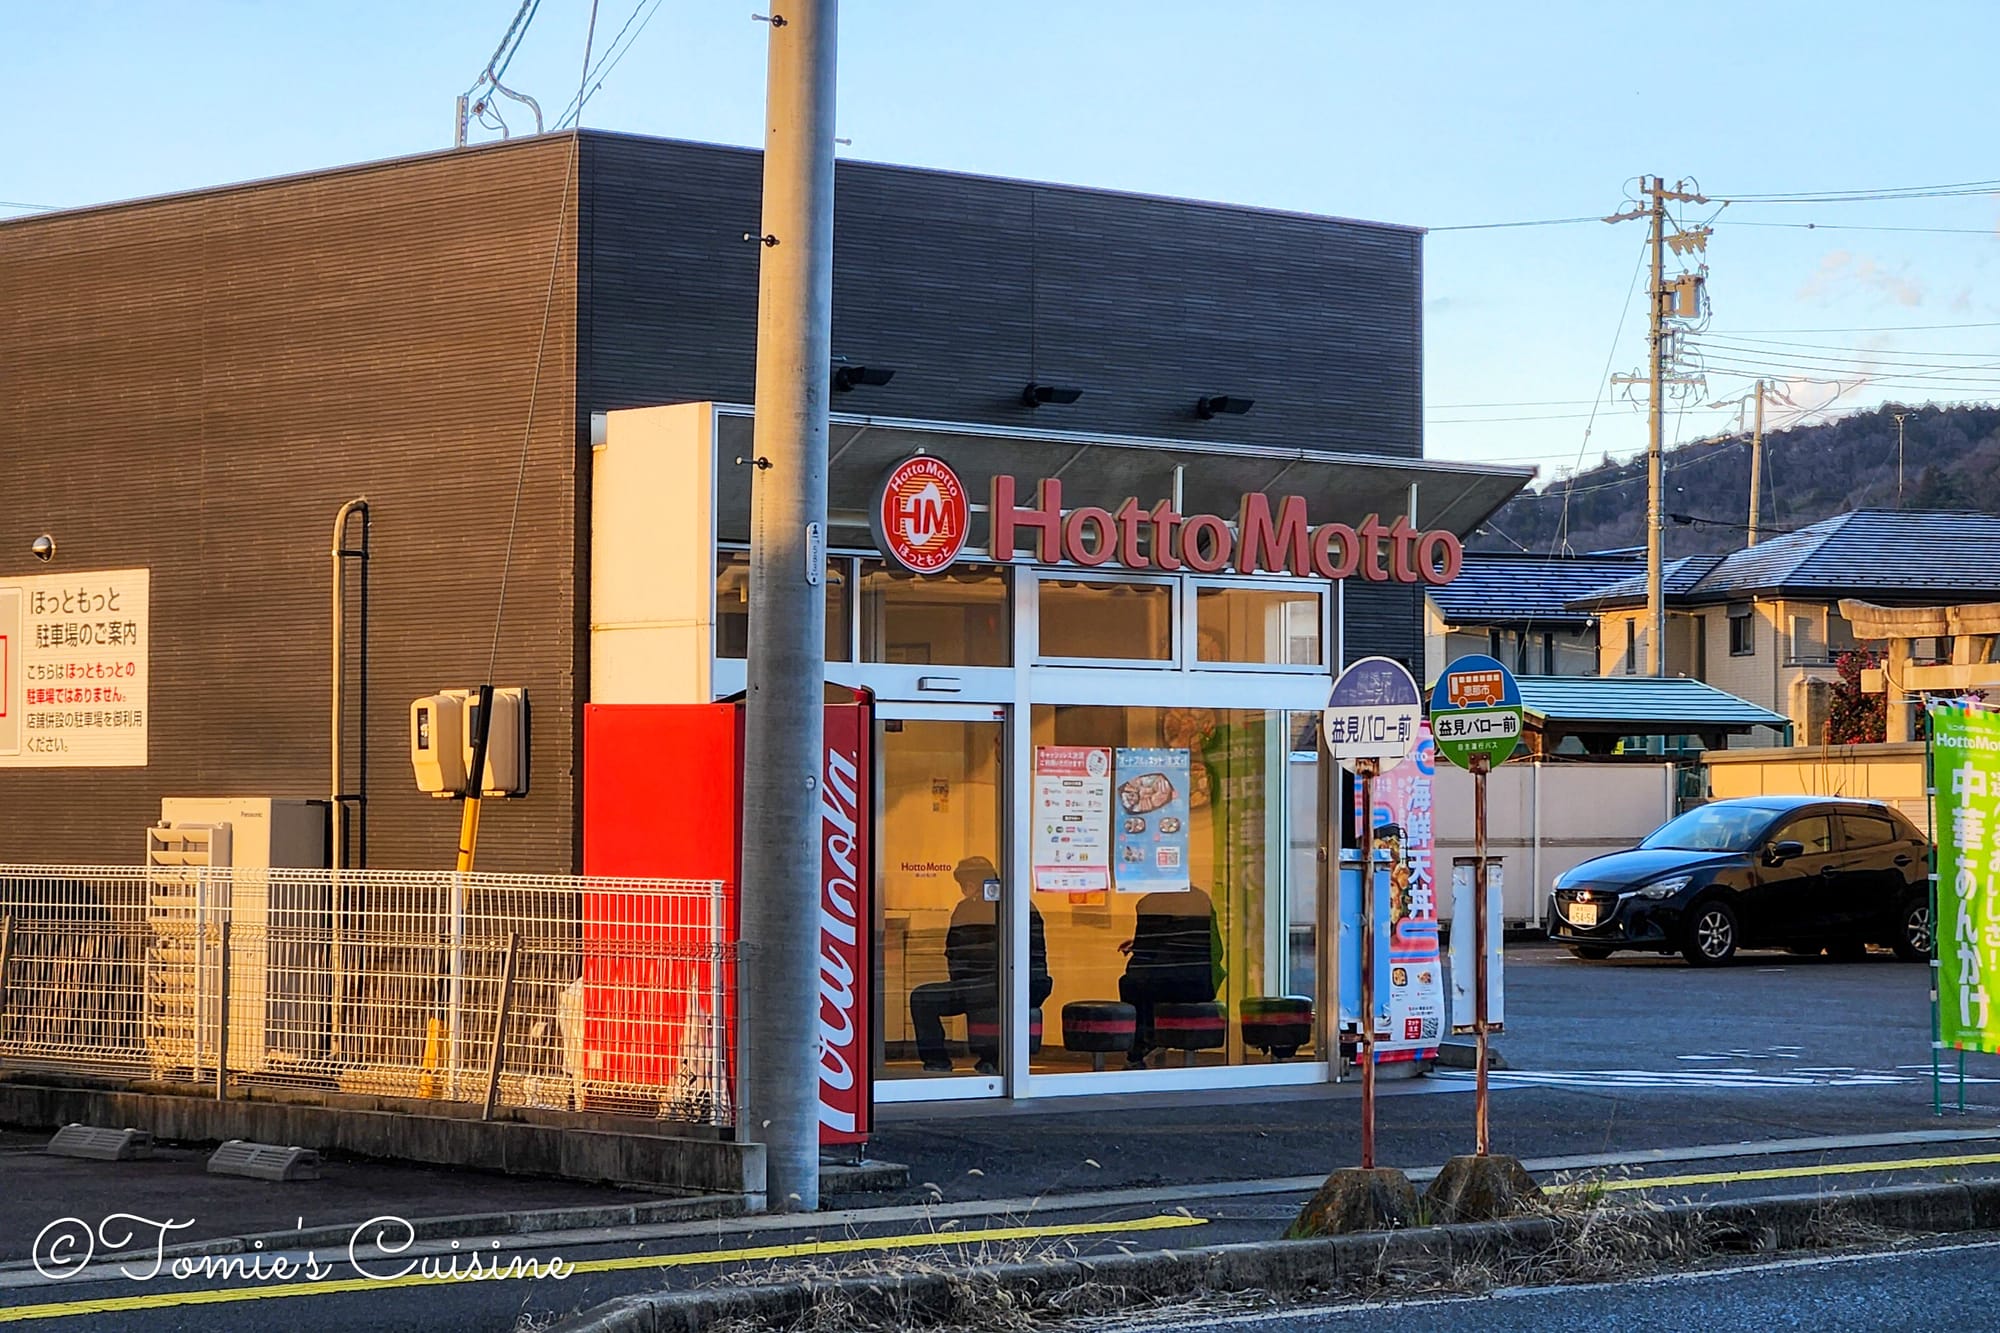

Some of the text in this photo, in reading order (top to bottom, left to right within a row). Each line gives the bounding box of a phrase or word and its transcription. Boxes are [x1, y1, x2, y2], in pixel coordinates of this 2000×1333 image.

[898, 543, 951, 567] ほっともっと
[30, 586, 121, 615] ほっともっと
[36, 620, 137, 649] 駐車場のご案内
[27, 661, 136, 680] こちらはほっともっとの
[27, 686, 127, 705] 駐車場ではありません。
[27, 710, 142, 728] 店舗併設の駐車場を御利用
[1331, 714, 1412, 743] 益見バロー前
[1439, 716, 1516, 737] 益見バロー前
[27, 736, 69, 753] ください。
[1936, 732, 2000, 751] HottoMo
[1407, 776, 1433, 921] 海鮮天丼
[1952, 761, 1990, 1029] 中華あんかけ
